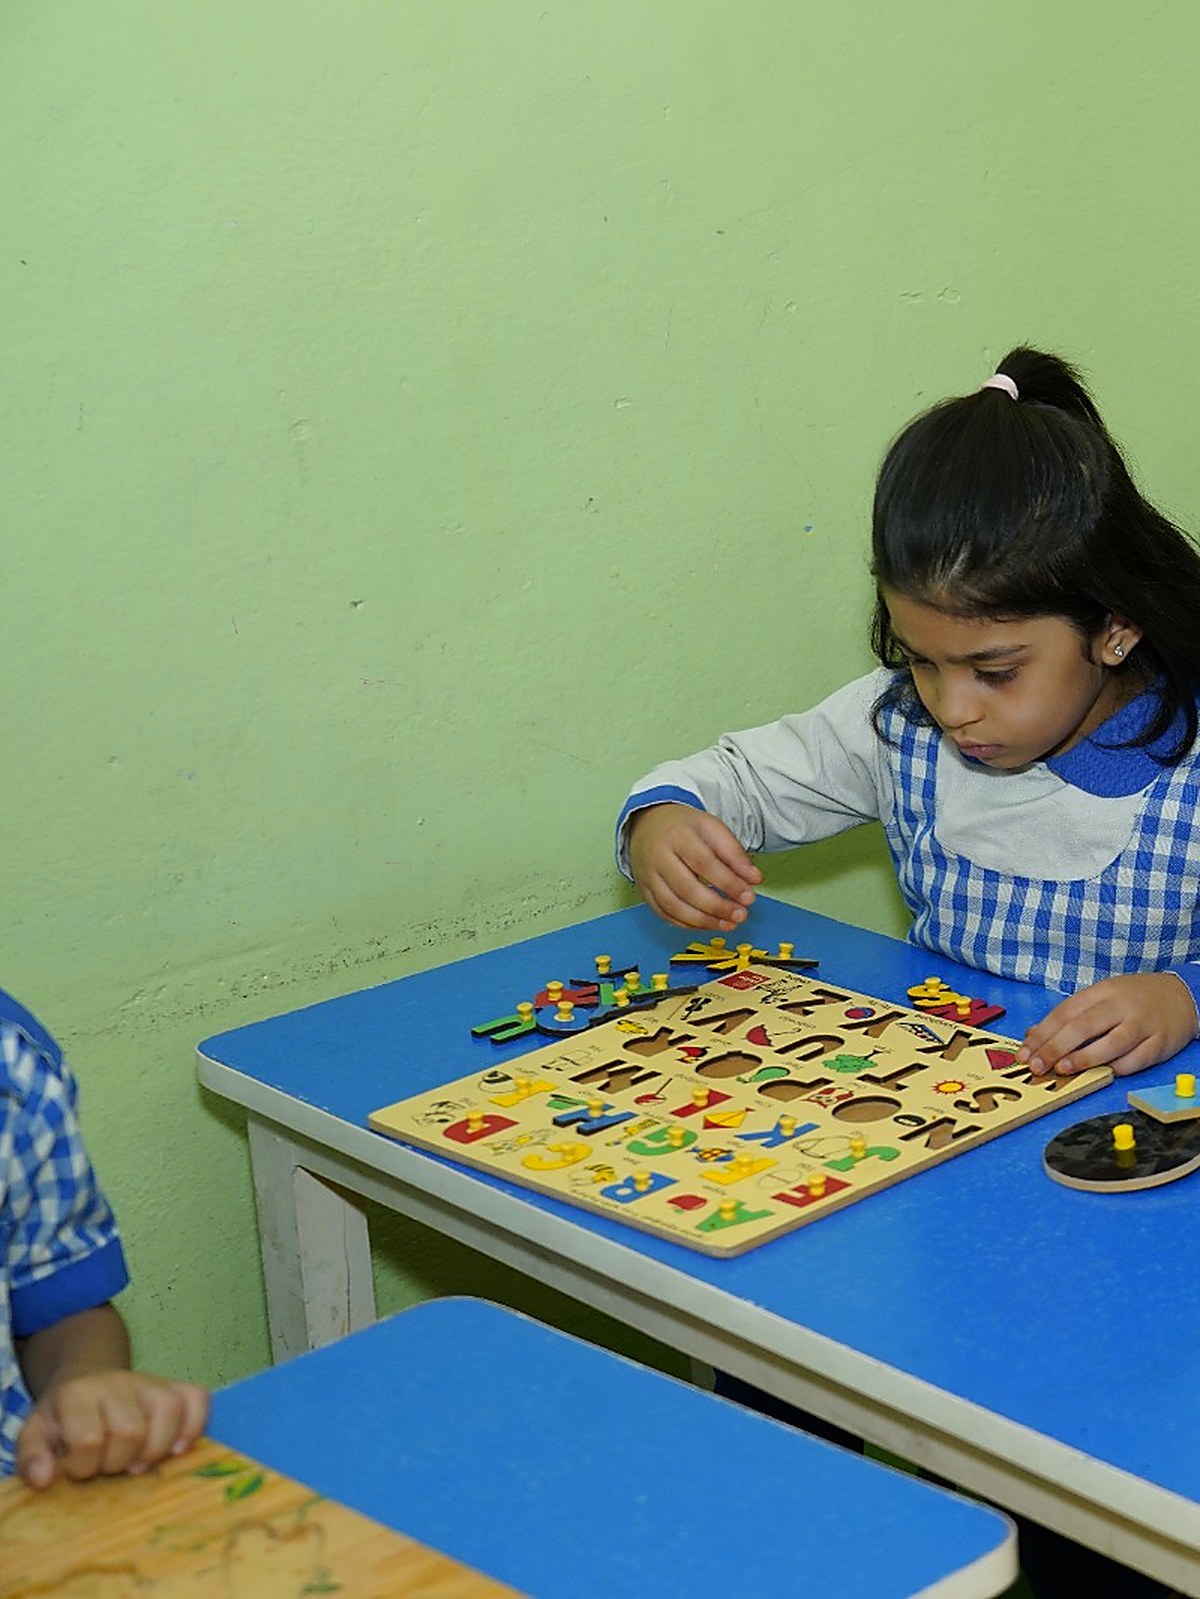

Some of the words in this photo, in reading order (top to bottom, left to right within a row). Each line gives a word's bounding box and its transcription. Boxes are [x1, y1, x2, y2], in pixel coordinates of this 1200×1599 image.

[777, 989, 851, 1016] Z
[686, 1008, 757, 1035] V
[839, 1012, 907, 1038] Y
[622, 1027, 697, 1057] R
[774, 1035, 844, 1062] U
[916, 1030, 998, 1062] X
[569, 1060, 662, 1094] M
[758, 1078, 834, 1103] P
[856, 1063, 930, 1092] T
[670, 1090, 732, 1118] L
[832, 1096, 901, 1123] O
[953, 1087, 1022, 1113] S
[443, 1115, 519, 1144] D
[552, 1104, 638, 1136] H
[735, 1115, 820, 1148] K
[898, 1117, 983, 1150] N
[627, 1126, 697, 1156] G
[521, 1143, 592, 1171] C
[699, 1157, 778, 1186] F
[822, 1147, 900, 1172] J
[600, 1172, 680, 1204] B
[772, 1177, 852, 1208] E
[695, 1200, 775, 1232] A
